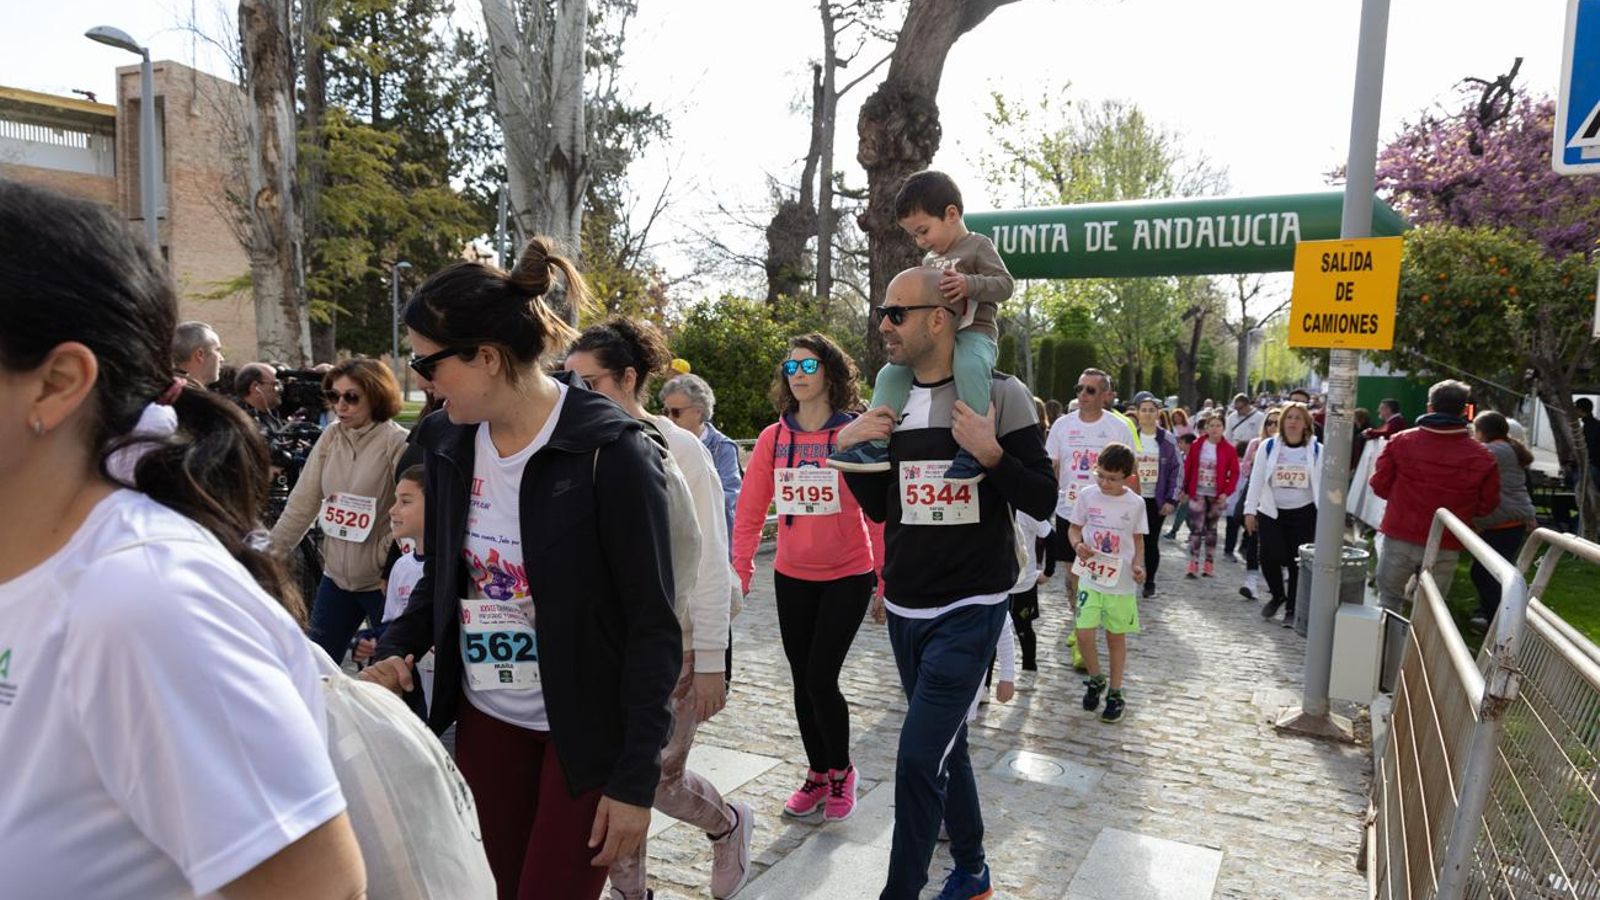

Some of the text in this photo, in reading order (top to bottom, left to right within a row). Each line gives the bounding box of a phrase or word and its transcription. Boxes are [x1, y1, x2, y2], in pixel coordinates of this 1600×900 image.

[992, 211, 1301, 254] JUNTA DE ANDALUCIA
[1321, 250, 1373, 273] SALIDA
[1335, 281, 1355, 302] DE
[1302, 313, 1378, 335] CAMIONES
[1276, 471, 1306, 482] 5073
[782, 485, 834, 503] 5195
[906, 483, 972, 506] 5344
[325, 506, 370, 530] 5520
[465, 631, 537, 664] 562
